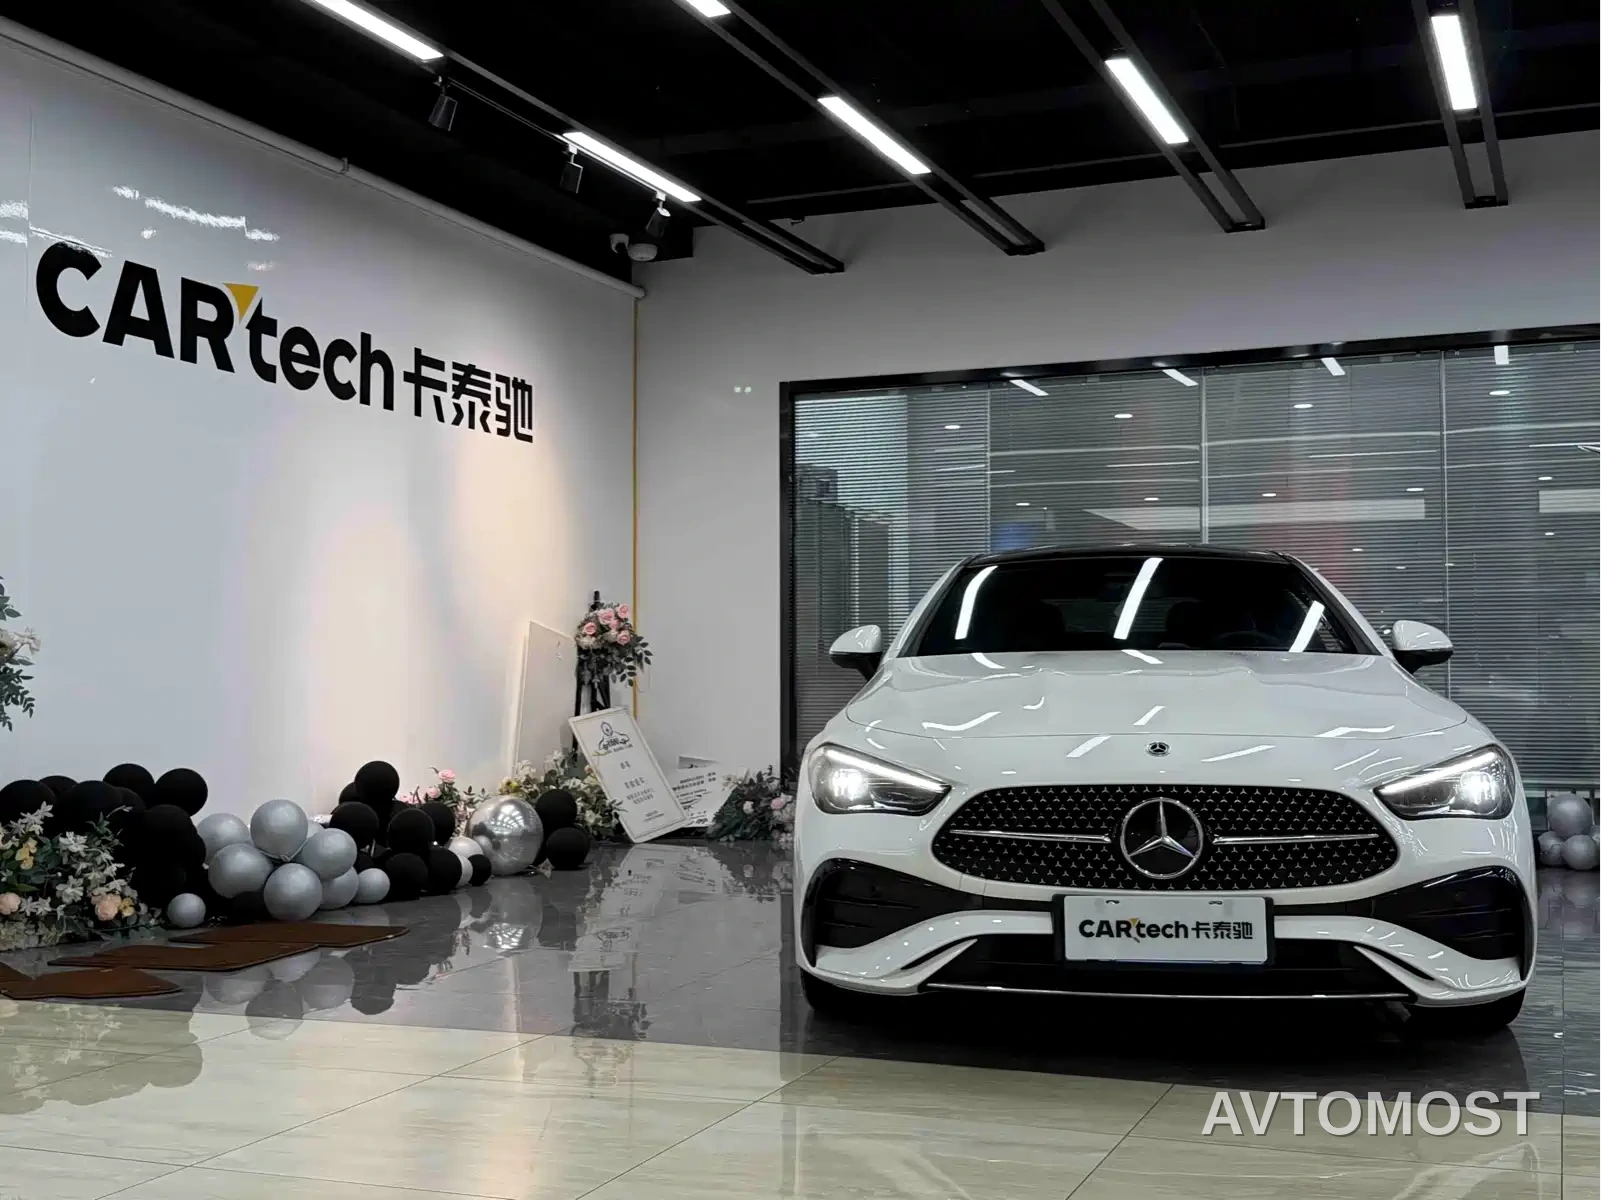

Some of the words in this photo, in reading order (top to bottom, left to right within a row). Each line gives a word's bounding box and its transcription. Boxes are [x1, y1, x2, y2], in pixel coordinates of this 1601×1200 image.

[403, 346, 534, 444] 卡泰驰
[1191, 921, 1253, 940] 卡泰驰
